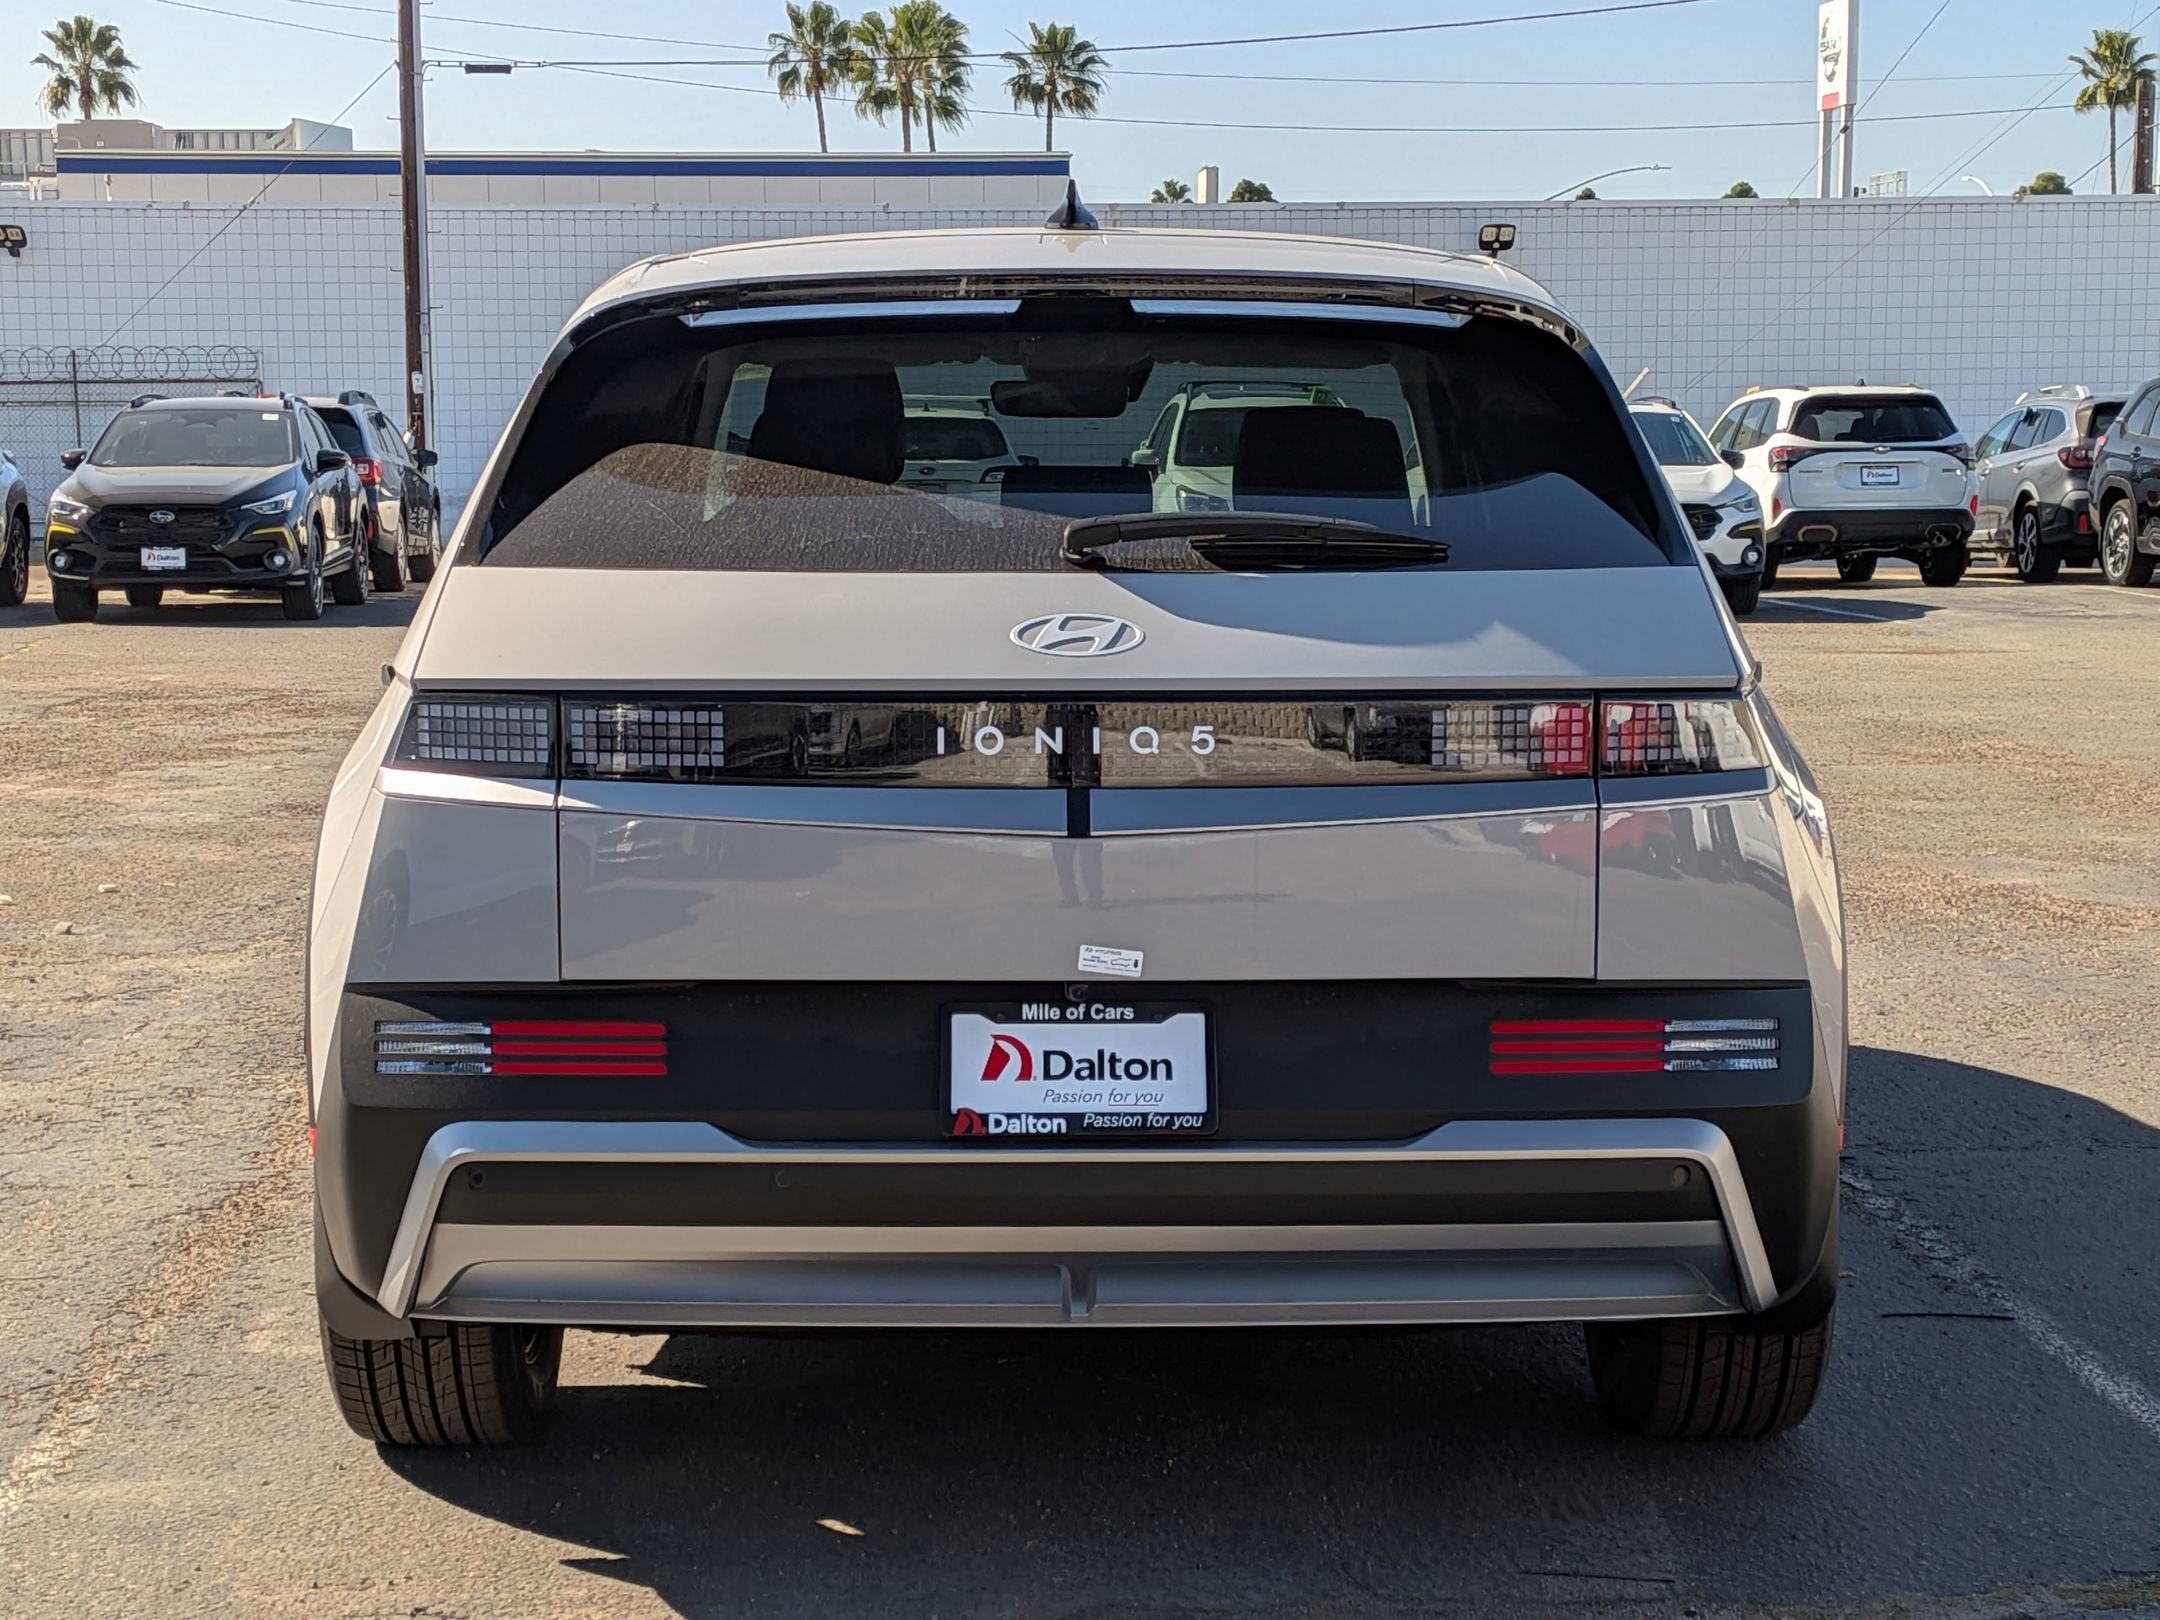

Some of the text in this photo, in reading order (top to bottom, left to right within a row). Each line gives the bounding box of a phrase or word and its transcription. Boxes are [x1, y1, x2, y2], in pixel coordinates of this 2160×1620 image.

[937, 725, 1215, 756] IONIQ 5
[1022, 1003, 1135, 1020] Mile of Cars
[1043, 1049, 1173, 1081] Dalton
[1042, 1088, 1164, 1105] Passion for you
[988, 1112, 1203, 1134] Dalton Passion for you
